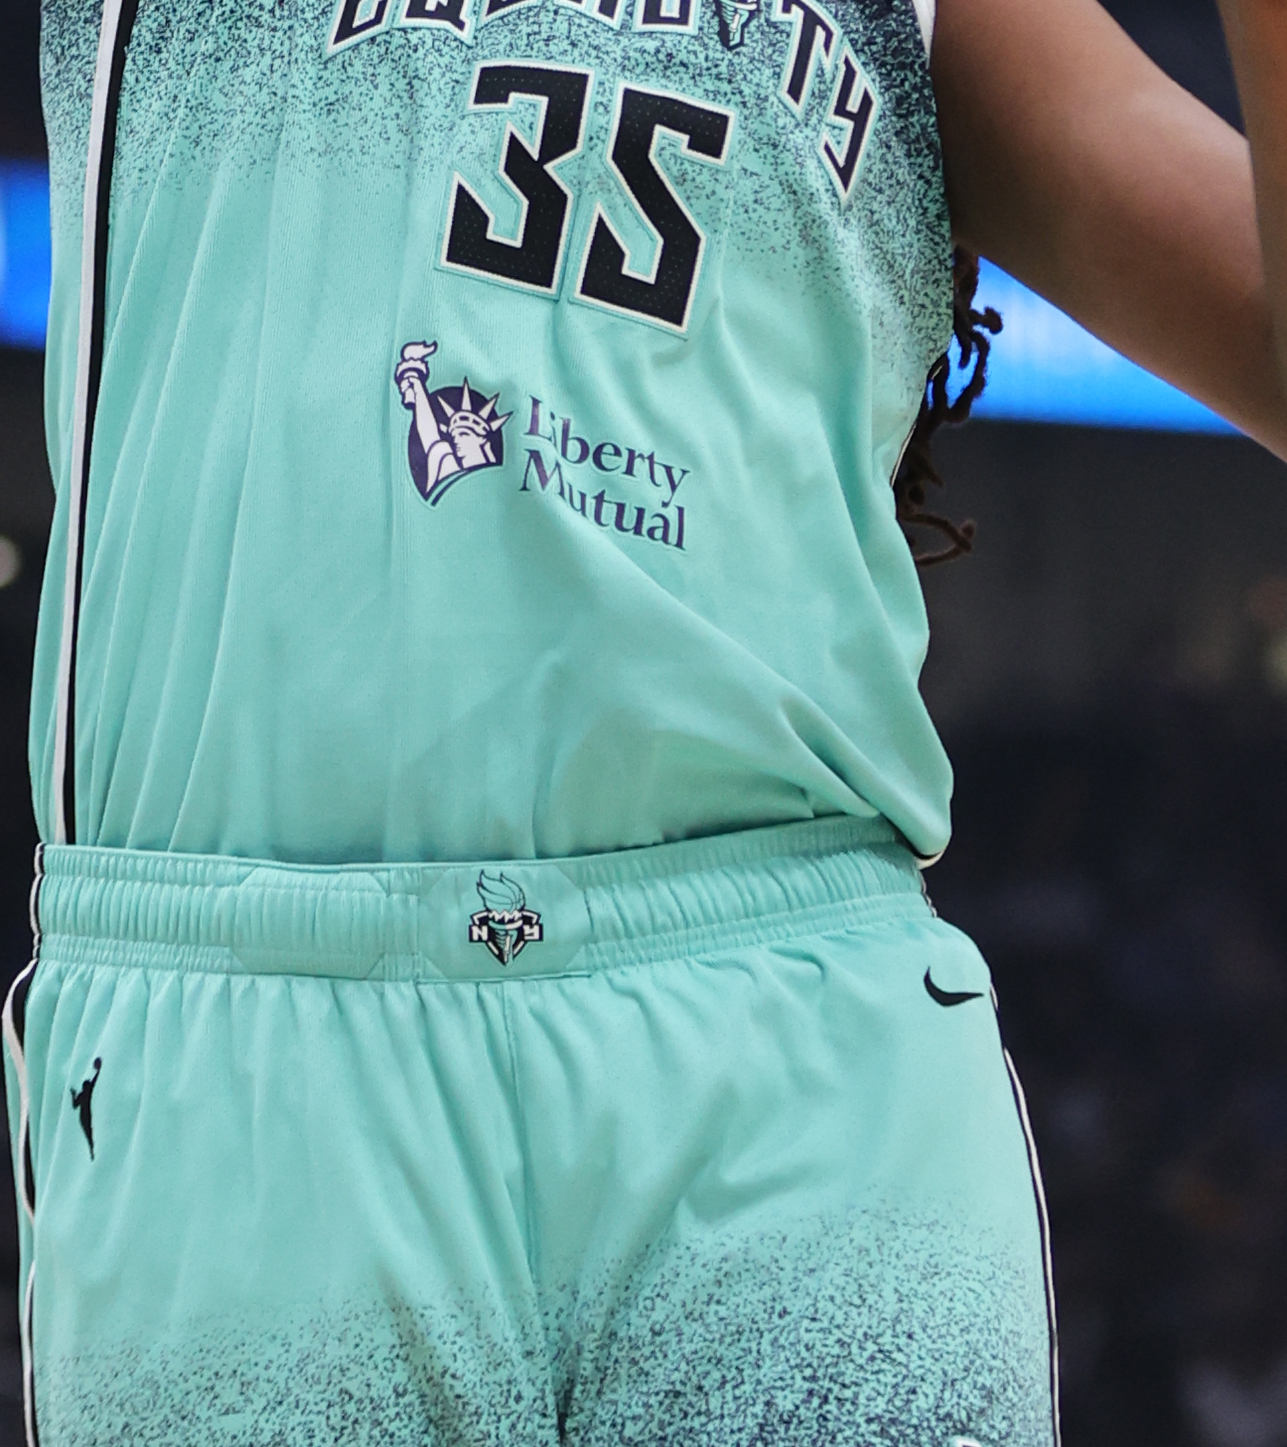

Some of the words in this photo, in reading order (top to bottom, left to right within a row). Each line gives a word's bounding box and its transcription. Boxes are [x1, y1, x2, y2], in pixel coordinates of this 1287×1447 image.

[436, 61, 736, 338] 35
[518, 448, 687, 552] Mutual
[523, 394, 691, 508] Liberty
